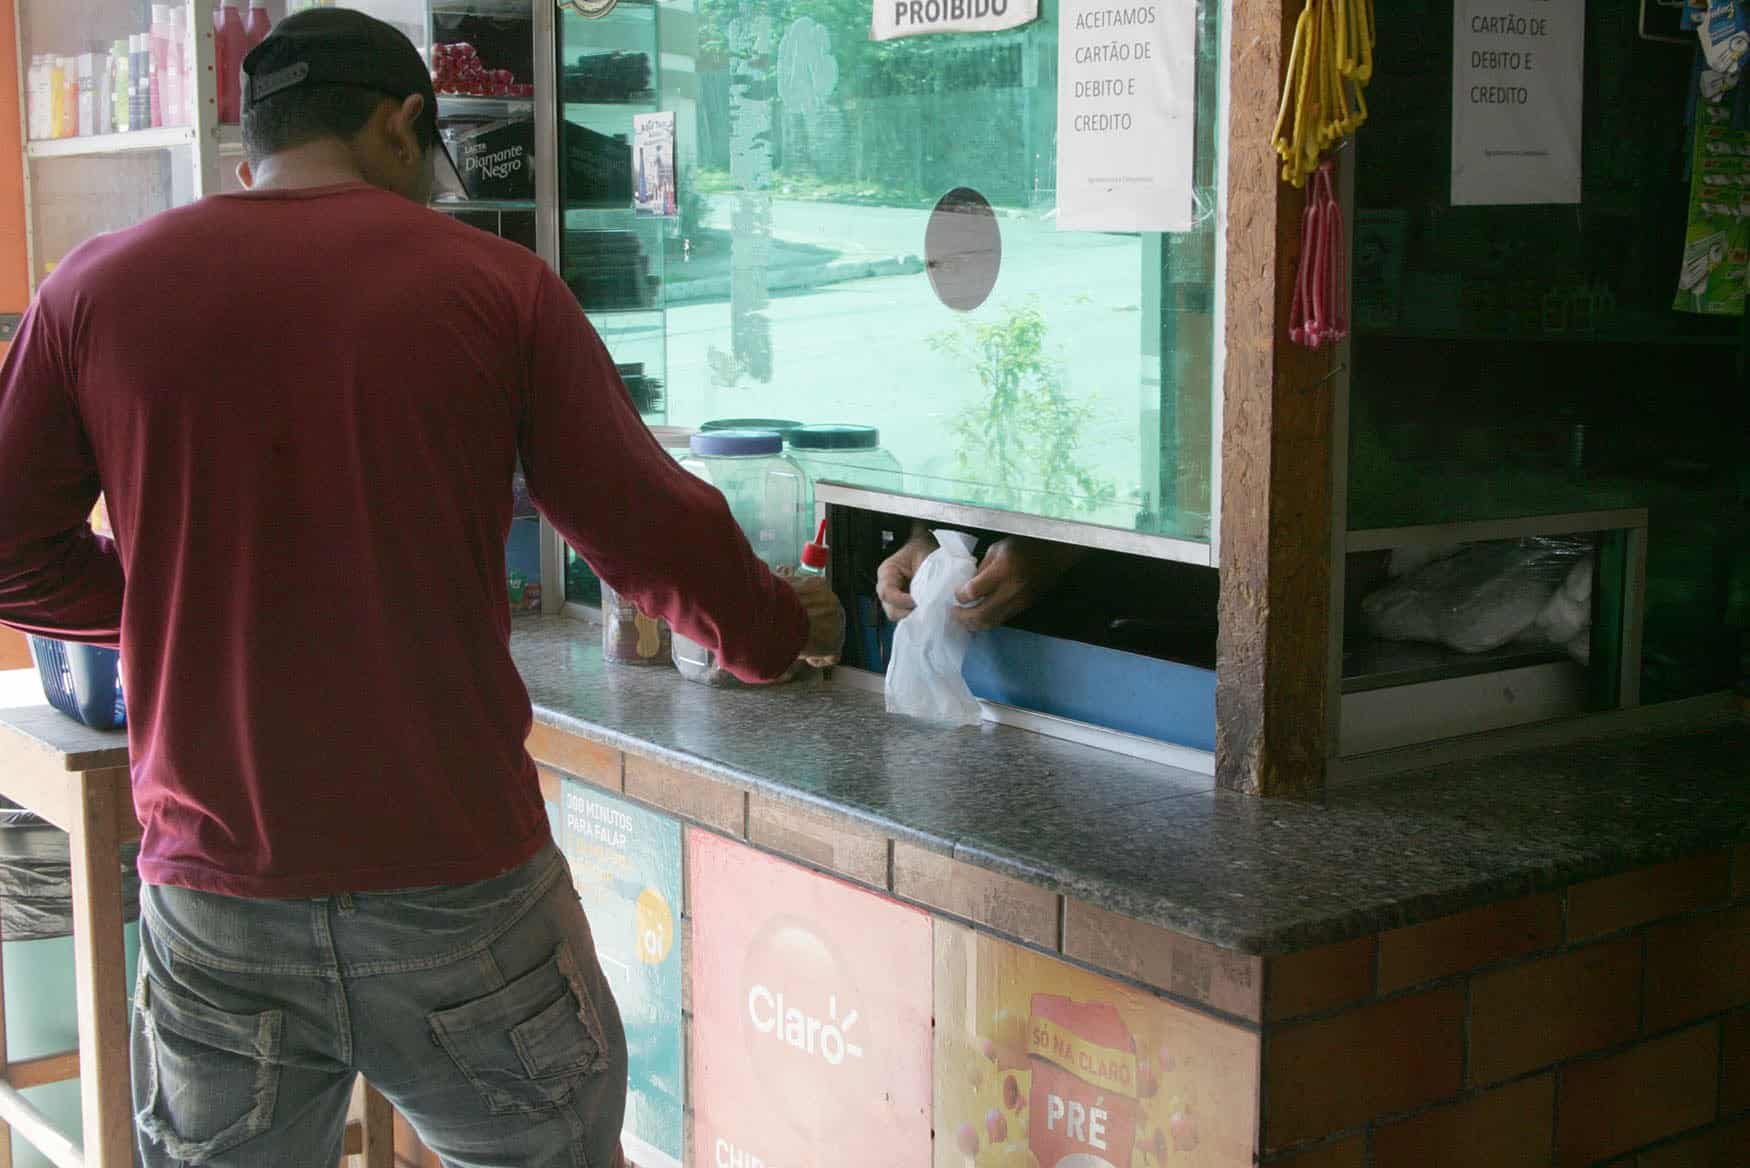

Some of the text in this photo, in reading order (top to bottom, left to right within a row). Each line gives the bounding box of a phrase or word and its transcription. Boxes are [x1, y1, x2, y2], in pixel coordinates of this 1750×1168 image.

[896, 0, 1007, 25] PROIBIDO
[1076, 6, 1155, 30] ACEITAMOS
[1471, 14, 1549, 36] CARTÃO DE
[1075, 41, 1152, 64] CARTÃO DE
[1471, 51, 1535, 70] DEBITO E
[1075, 78, 1136, 98] DEBITO E
[1470, 86, 1528, 105] CREDITO
[1074, 113, 1132, 132] CREDITO
[465, 145, 523, 172] Diamante
[481, 159, 521, 181] Negro
[586, 800, 633, 832] MINUTOS
[567, 814, 626, 849] PARA FALAR
[749, 985, 846, 1065] Claro
[1032, 1024, 1050, 1049] SÓ
[1079, 1051, 1132, 1087] CLARO
[1047, 1095, 1108, 1152] PRÉ
